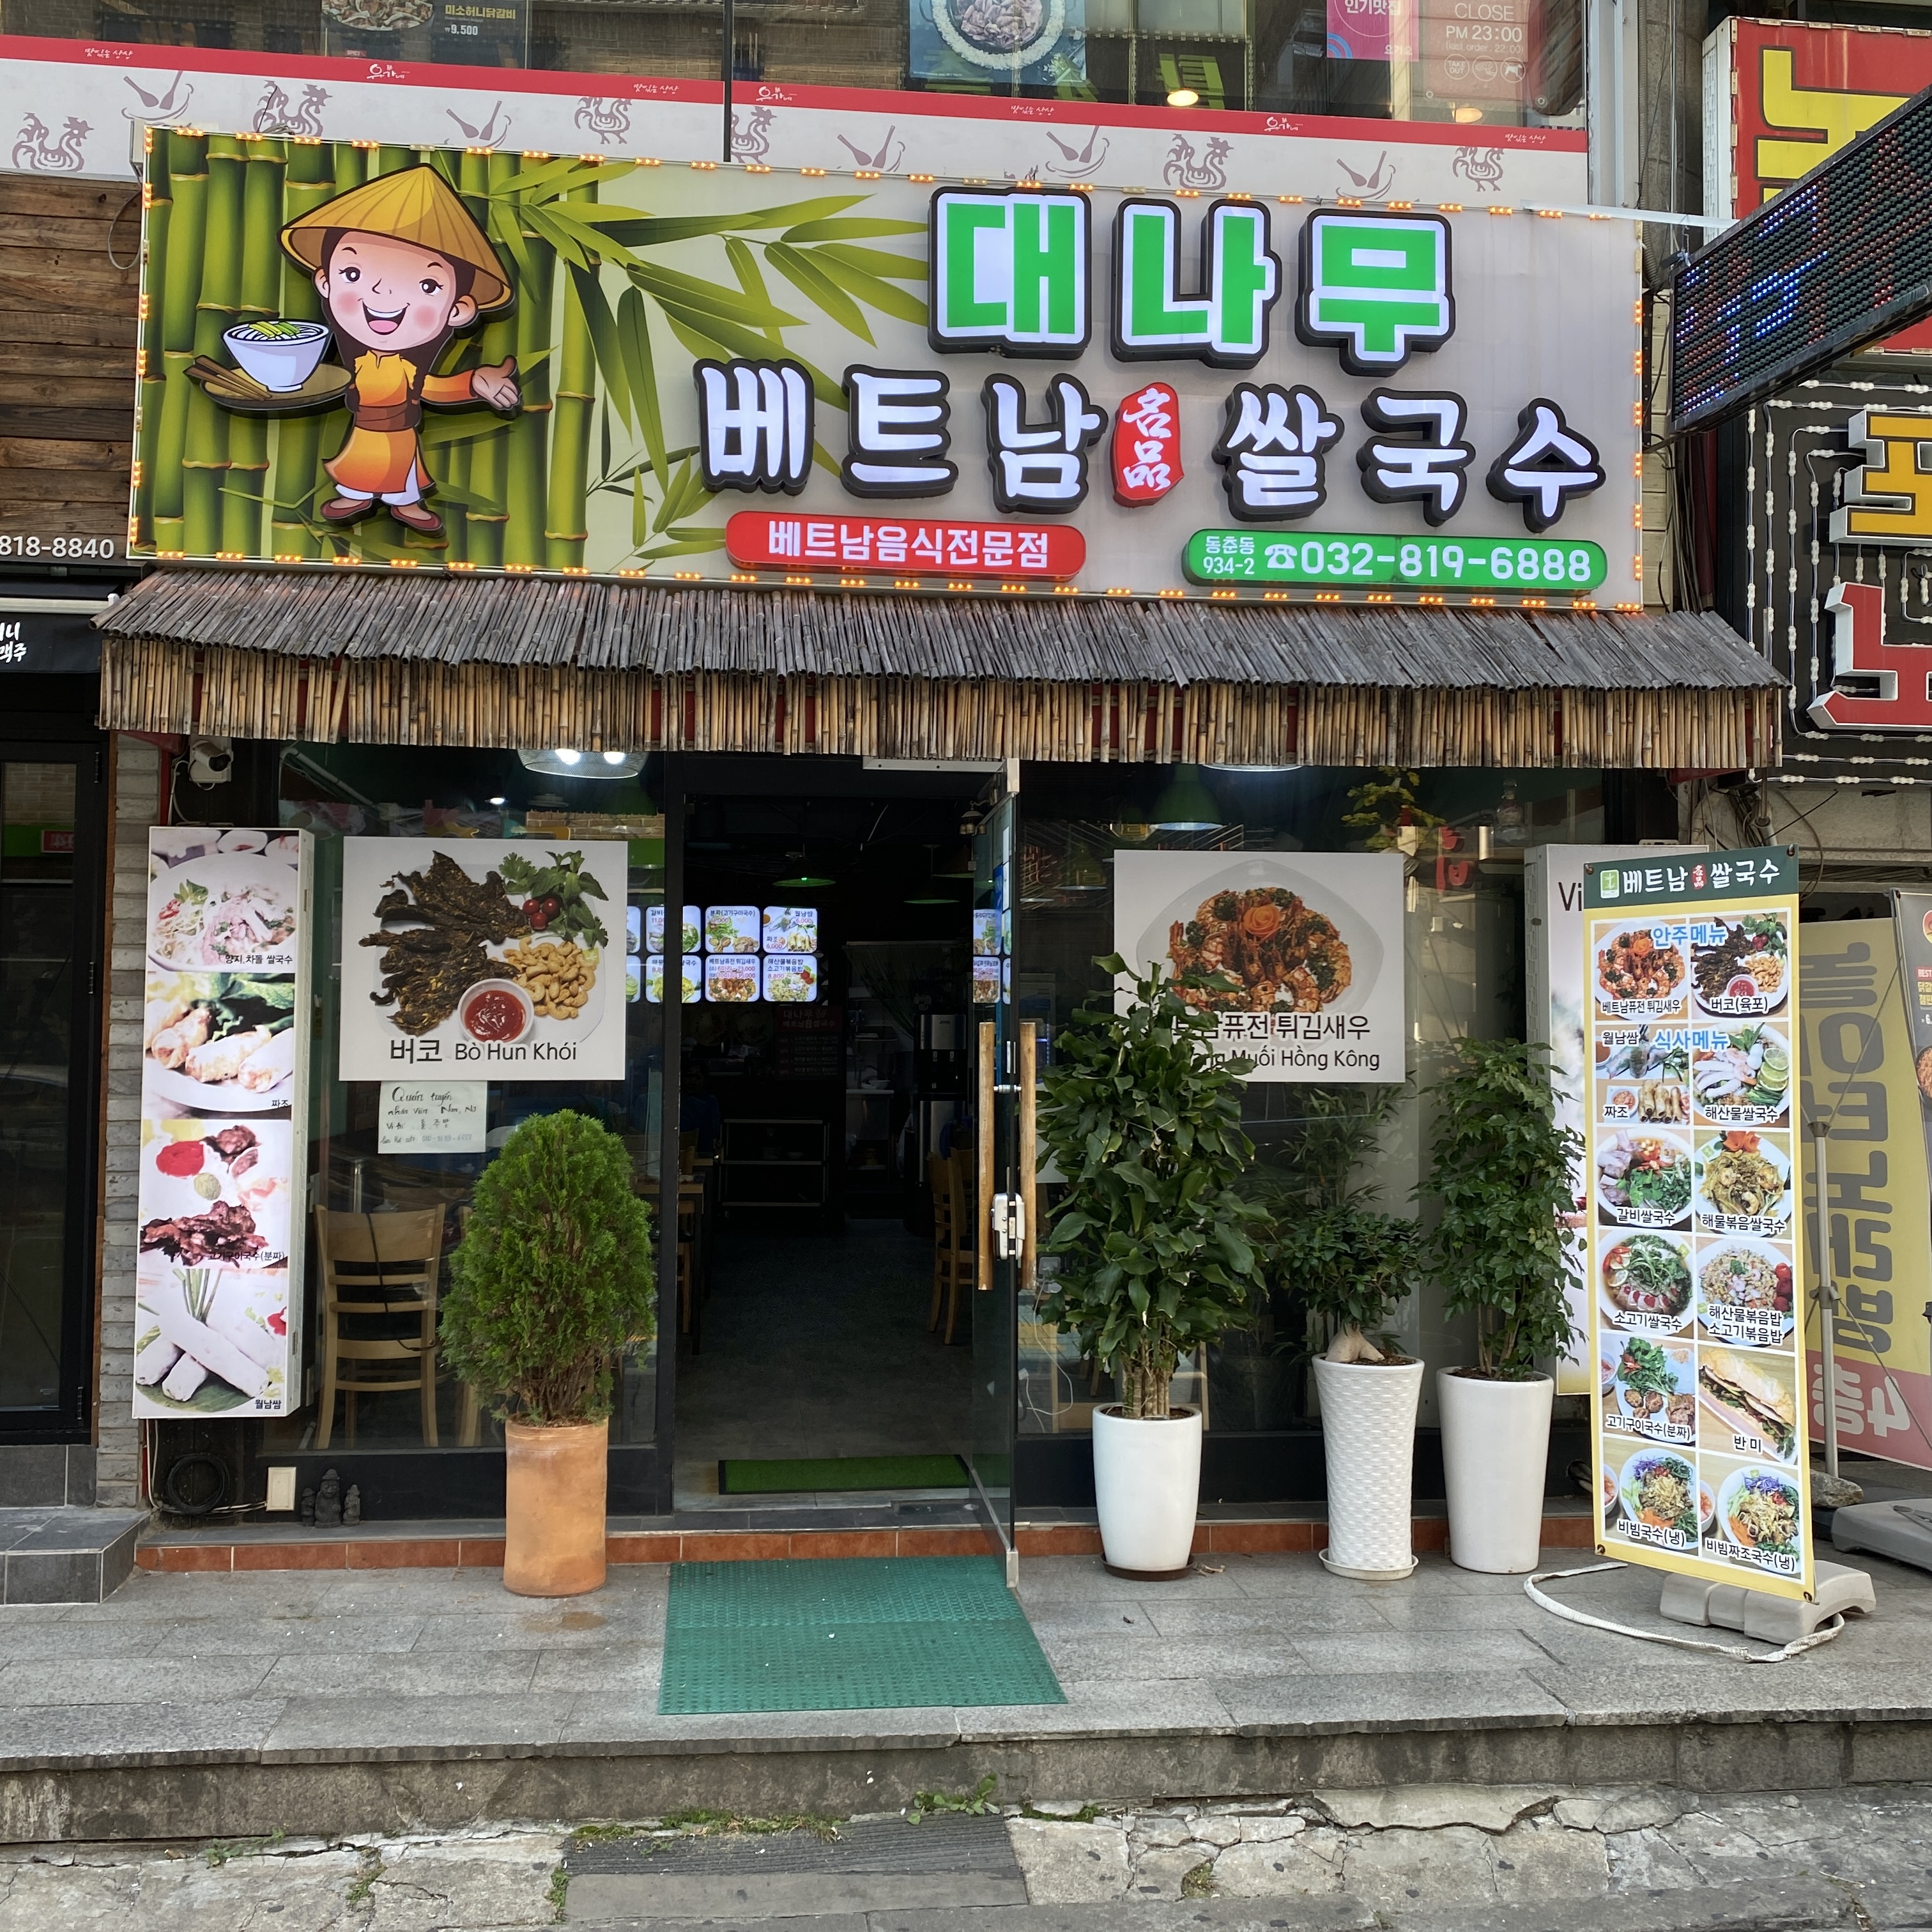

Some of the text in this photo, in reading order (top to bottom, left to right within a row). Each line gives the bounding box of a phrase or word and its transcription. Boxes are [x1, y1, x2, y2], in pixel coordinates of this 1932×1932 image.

[445, 4, 516, 20] 미소허니닭갈비
[1454, 3, 1515, 21] CLOSE
[1446, 24, 1523, 43] PM 23:00
[1384, 44, 1413, 56] 요기요
[935, 190, 1449, 363] 대나무
[700, 365, 1101, 500] 베트남
[1225, 389, 1599, 519] 쌀국수
[768, 520, 1048, 569] 베트남음식전문점
[1204, 535, 1255, 555] 동춘동
[1202, 556, 1255, 575] 934-2
[1300, 540, 1592, 582] 032-819-6888
[1622, 866, 1689, 894] 베트남
[1710, 858, 1781, 889] 쌀국수
[1652, 924, 1726, 948] 안주메뉴
[266, 954, 293, 964] 쌀국수
[1602, 1000, 1681, 1014] 베트남퓨전 튀김새우
[1711, 995, 1768, 1013] 버코(육포)
[1276, 1014, 1370, 1040] 튀김새우
[1602, 1031, 1638, 1045] 월남쌈
[1654, 1030, 1729, 1050] 식사메뉴
[390, 1038, 578, 1064] 버코 Bò Hun Khói
[1281, 1045, 1328, 1071] Hồng
[1333, 1050, 1380, 1071] Kông
[271, 1100, 289, 1108] 짜조
[1604, 1105, 1629, 1119] 짜조
[1705, 1106, 1778, 1122] 해산물쌀국수
[1616, 1207, 1676, 1225] 갈비쌀국수
[1702, 1215, 1786, 1234] 해물볶음쌀국수
[1613, 1312, 1683, 1331] 소고기쌀국수
[1708, 1305, 1783, 1327] 해산물볶음밥
[1708, 1322, 1783, 1344] 소고기볶음밥
[255, 1399, 282, 1409] 월남쌈
[1606, 1414, 1692, 1440] 고기구이국수(분짜)
[1618, 1519, 1686, 1547] 비빔국수(냉)
[1706, 1539, 1796, 1572] 비빔짜조국수(냉)
